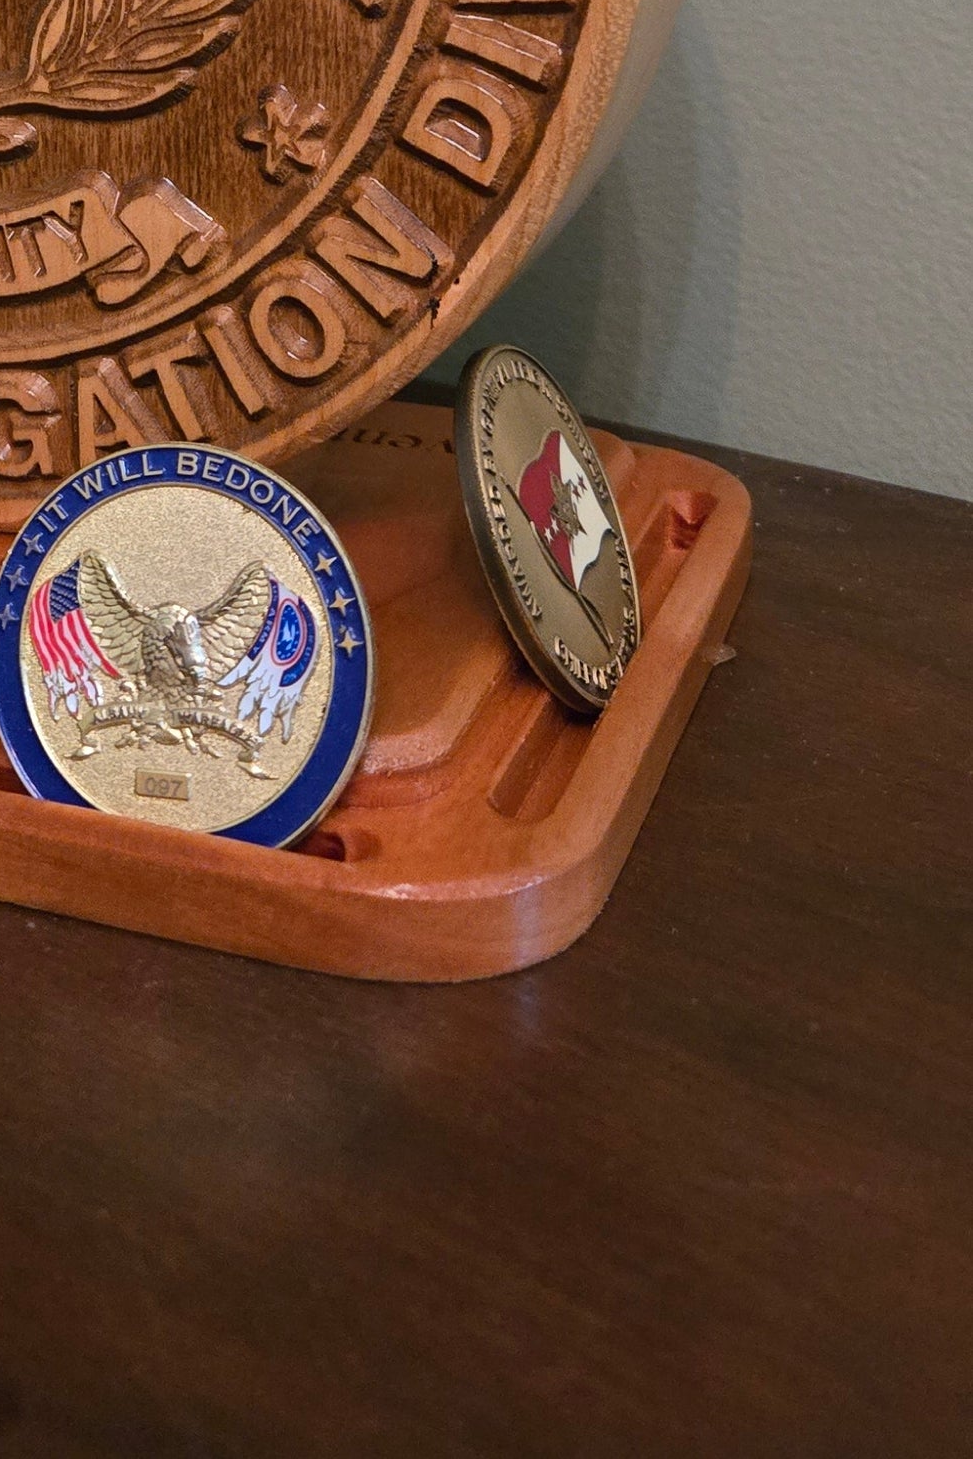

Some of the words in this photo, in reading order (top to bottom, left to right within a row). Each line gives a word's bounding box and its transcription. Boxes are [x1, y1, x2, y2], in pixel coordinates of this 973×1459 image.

[37, 496, 70, 534] IT
[72, 451, 164, 501] WILL
[143, 776, 183, 797] 097
